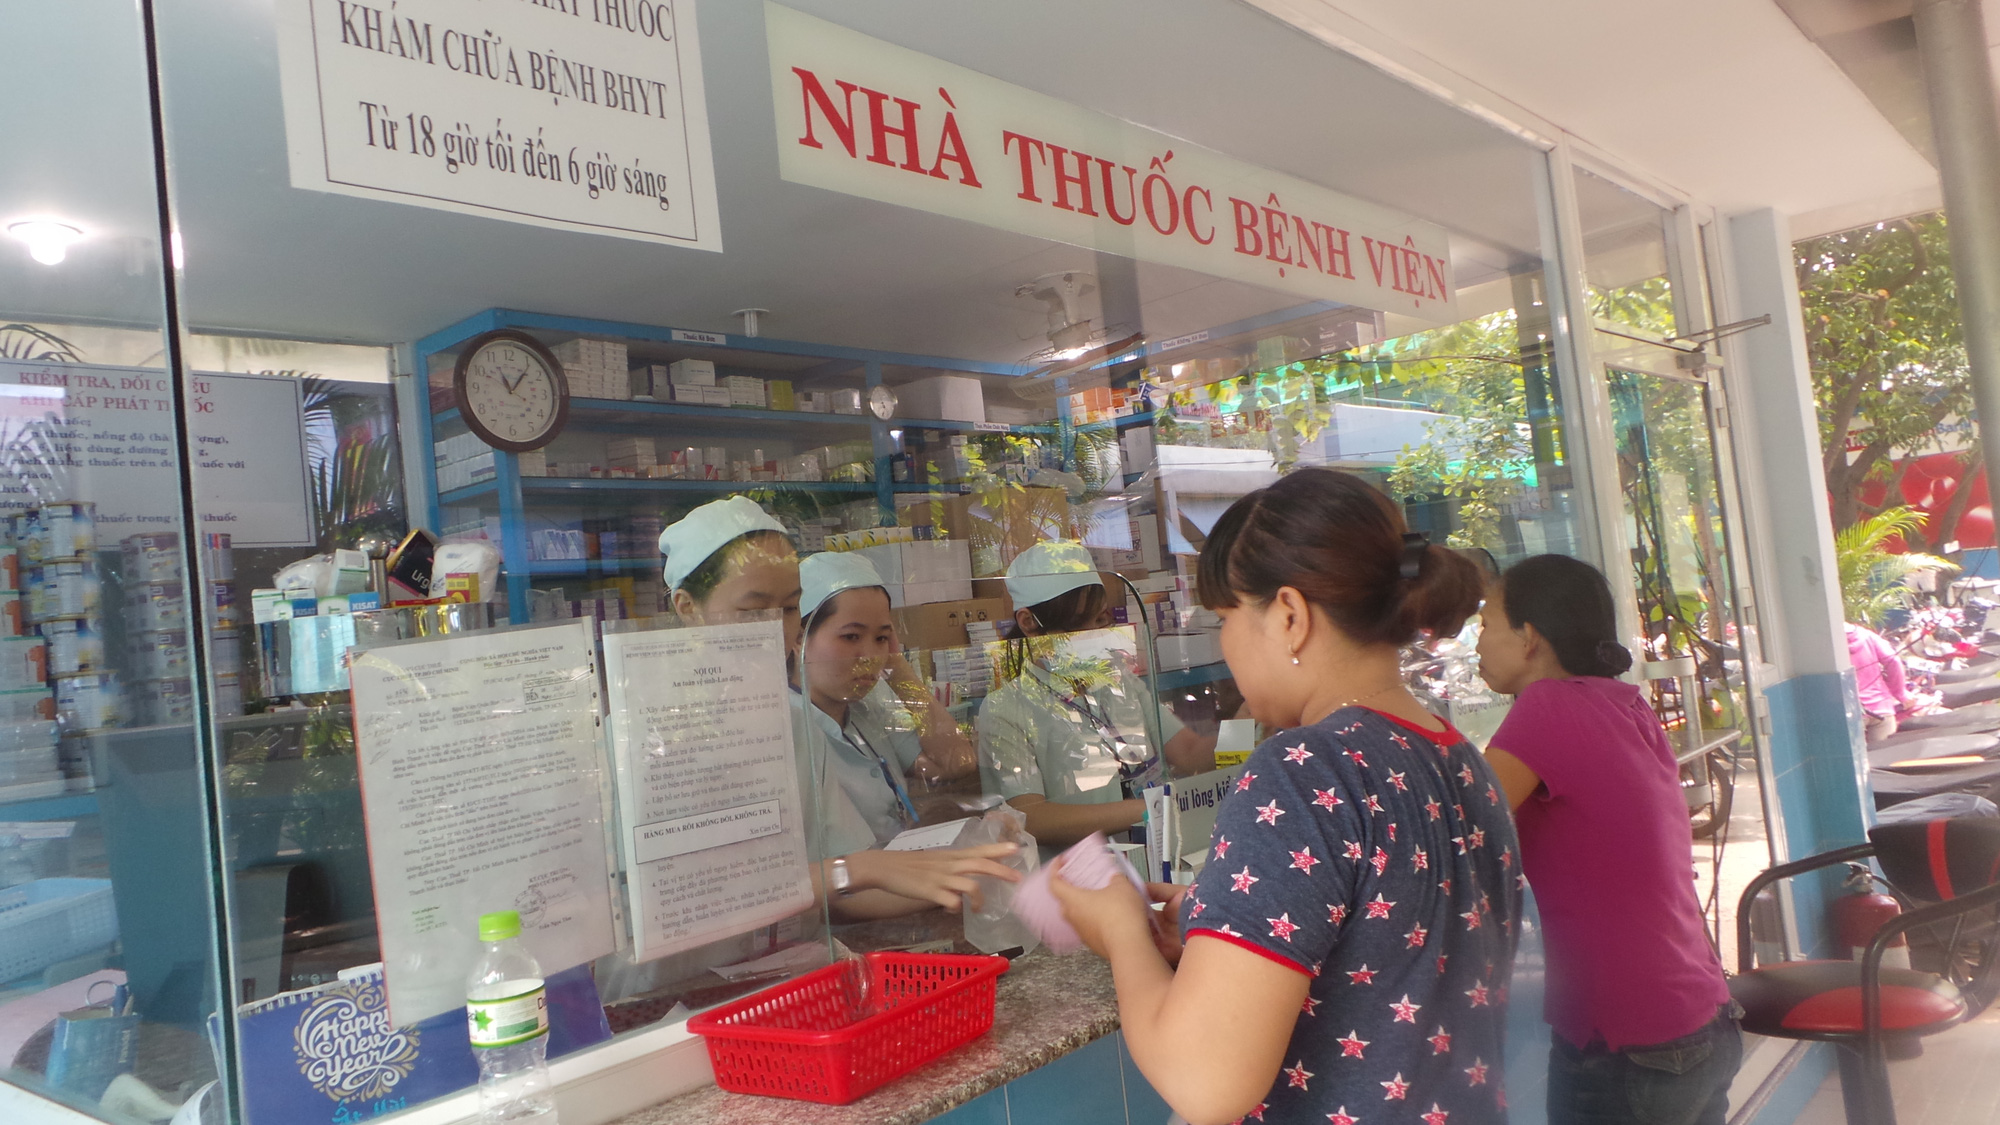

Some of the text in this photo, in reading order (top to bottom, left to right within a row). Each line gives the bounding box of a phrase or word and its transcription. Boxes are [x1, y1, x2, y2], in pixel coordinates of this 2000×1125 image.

[340, 1, 668, 119] KHÁM CHỮA BỆNH BHYT
[359, 101, 670, 211] Từ 18 giờ tối đến 6 giờ sáng
[792, 67, 1449, 309] NHÀ THUỐC BỆNH VIỆN
[486, 351, 496, 363] 11
[504, 350, 515, 362] 12
[474, 364, 486, 376] 10
[536, 370, 542, 381] 2
[19, 368, 69, 387] KIỂM
[74, 376, 115, 389] TRA,
[120, 374, 150, 391] ĐỐI
[472, 382, 480, 394] 9
[541, 389, 548, 400] 3
[103, 394, 150, 411] PHÁT
[478, 403, 486, 414] 8
[536, 409, 544, 420] 4
[490, 418, 498, 429] 7
[528, 422, 534, 433] 5
[509, 424, 517, 436] 6
[352, 601, 377, 611] KISAT
[1191, 788, 1214, 808] lòng
[665, 824, 681, 835] MUA
[315, 1032, 391, 1059] New
[307, 1049, 385, 1088] Year
